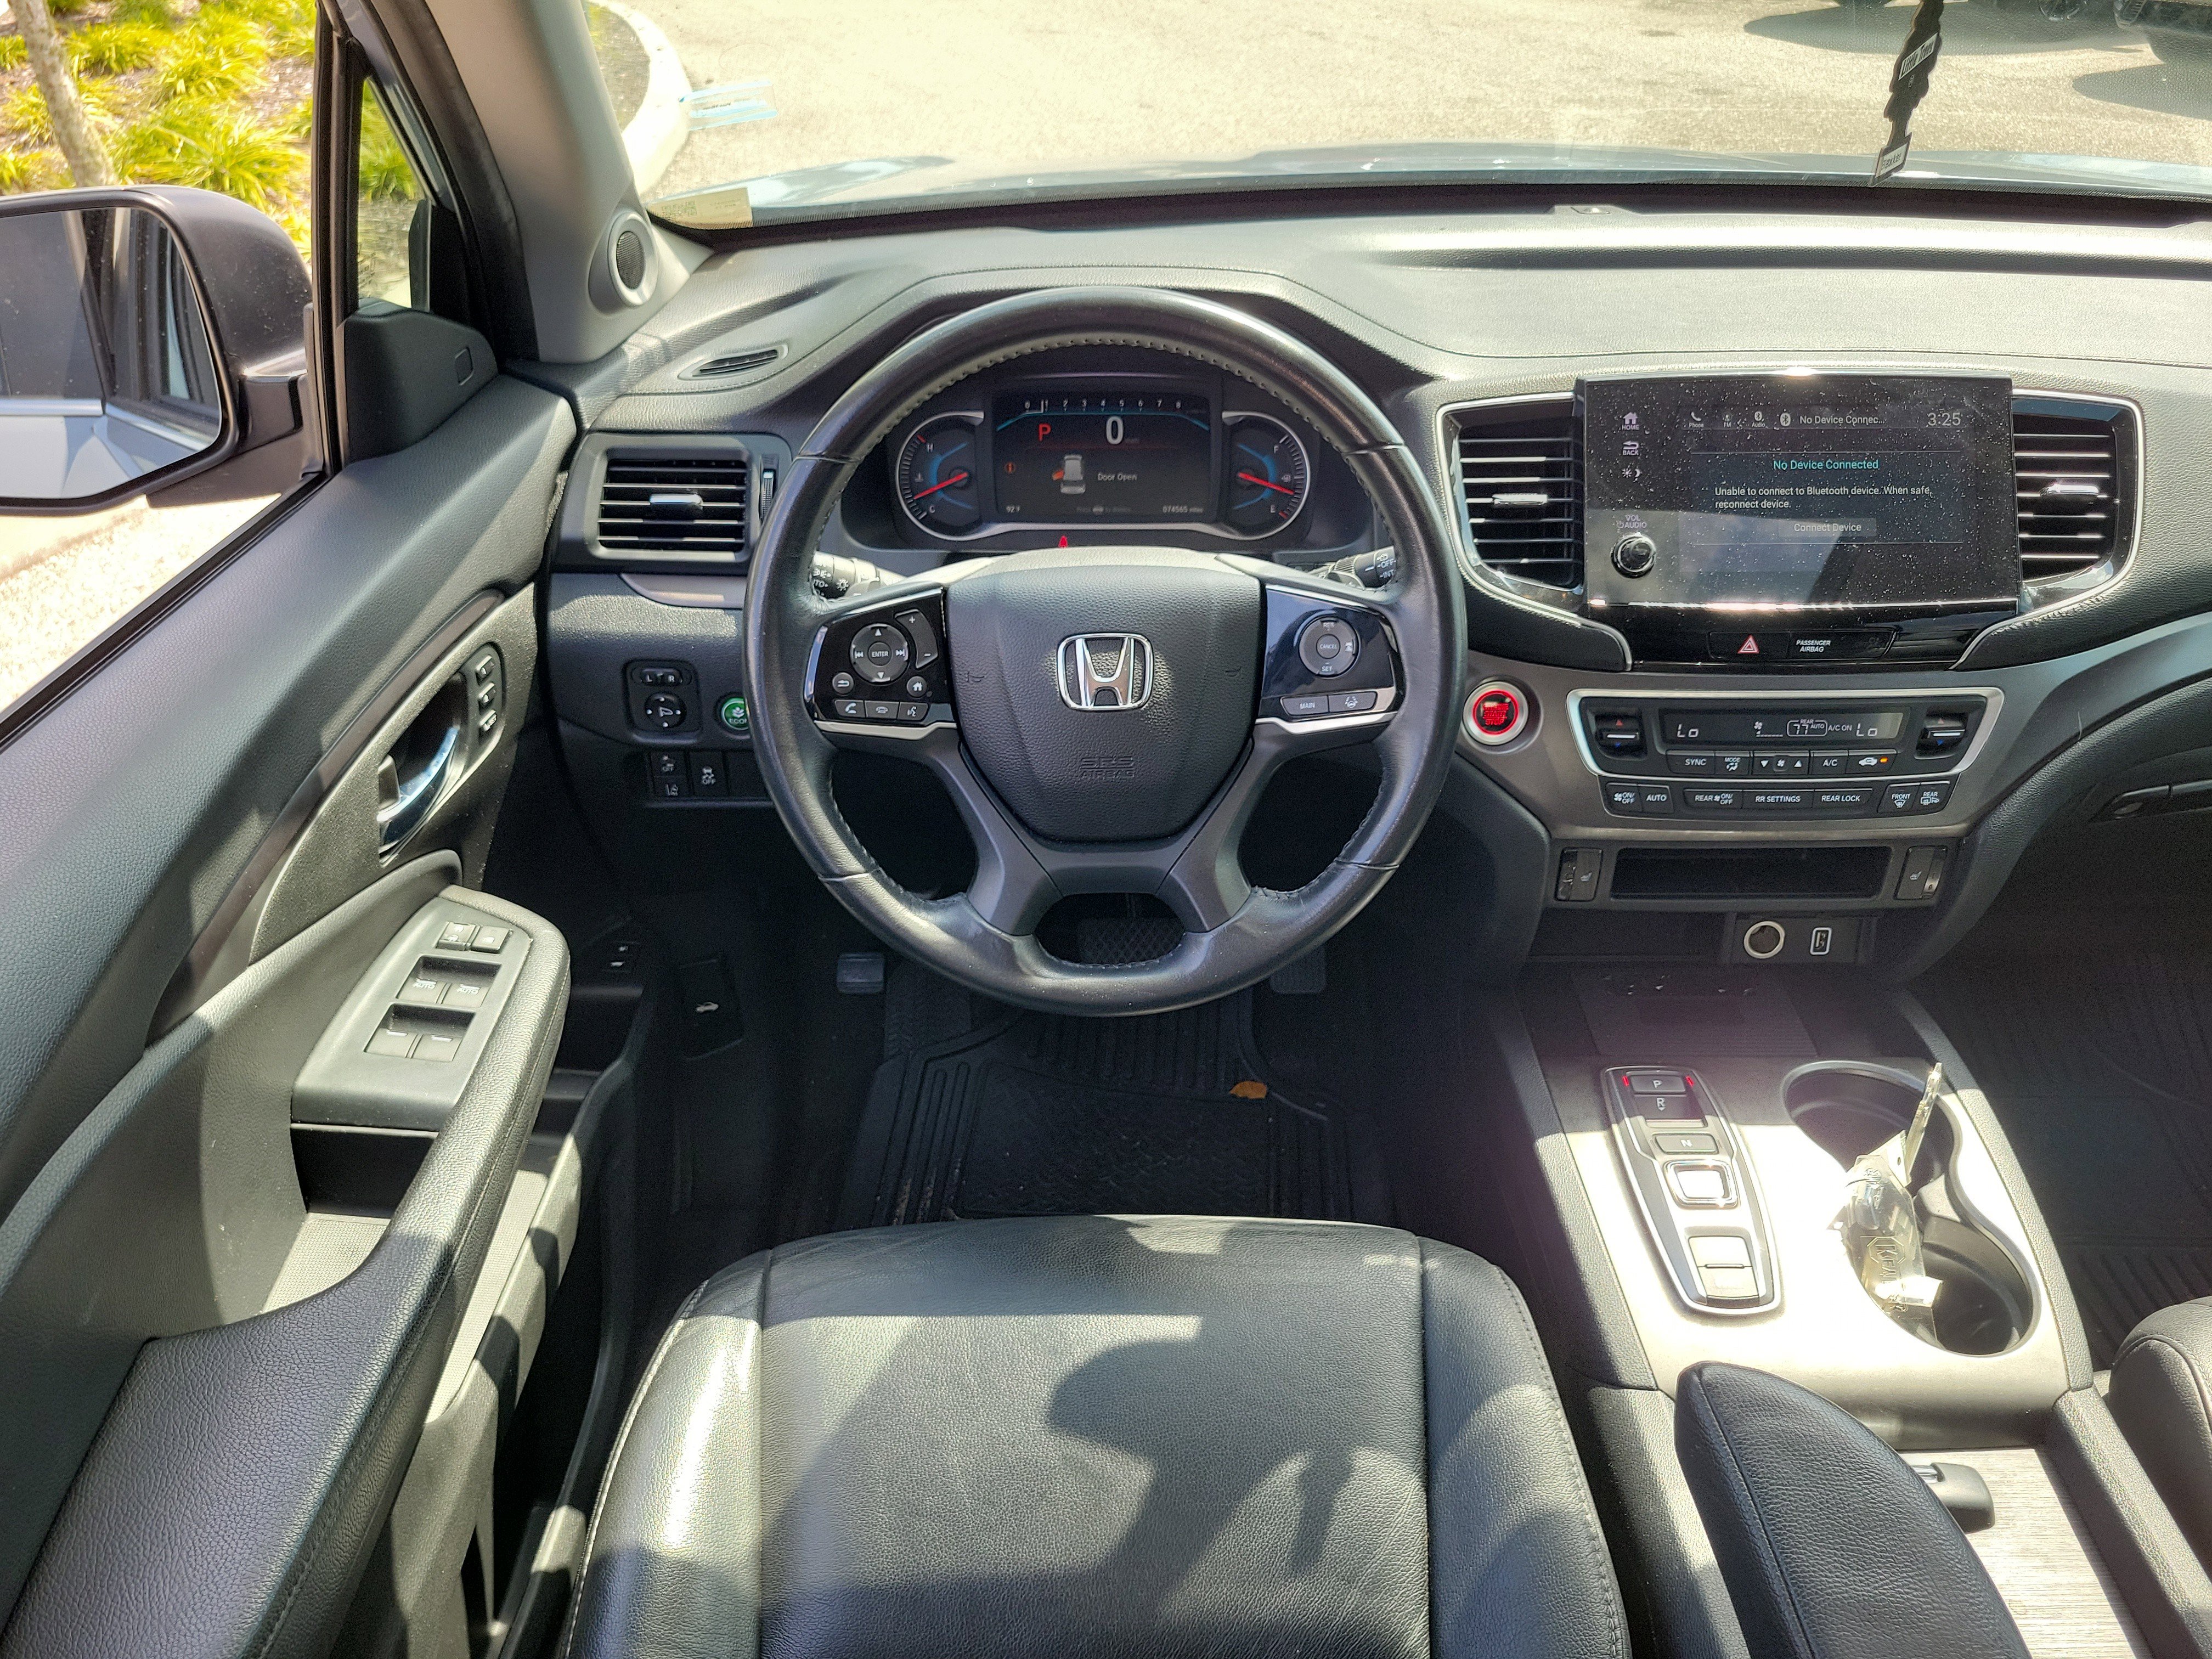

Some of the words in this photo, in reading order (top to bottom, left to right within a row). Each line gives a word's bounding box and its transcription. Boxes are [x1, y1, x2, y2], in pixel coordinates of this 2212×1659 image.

[1799, 416, 1812, 424] No
[1815, 415, 1843, 424] Device
[1928, 413, 1961, 426] 3:25
[1039, 423, 1051, 441] P
[1106, 416, 1124, 444] 0
[927, 443, 933, 453] H
[1773, 461, 1787, 470] No
[1791, 460, 1823, 470] Device
[1826, 460, 1879, 469] Connected
[1098, 473, 1115, 481] Door
[1118, 473, 1137, 483] Open
[1715, 487, 1745, 495] Unable
[1807, 487, 1848, 495] Bluetooth
[1851, 487, 1881, 495] device.
[1883, 487, 1908, 495] When
[929, 505, 935, 513] C
[1716, 500, 1758, 509] reconnect
[1761, 500, 1791, 509] device.
[1794, 523, 1830, 532] Connect
[1832, 523, 1861, 532] Device
[1677, 724, 1699, 738] Lo
[1793, 724, 1809, 735] 77
[1856, 723, 1878, 737] Lo
[1685, 758, 1707, 766] SYNC
[1822, 759, 1837, 767] A/C
[1652, 1080, 1662, 1088] P
[1657, 1097, 1666, 1108] R
[1681, 1139, 1692, 1147] N
